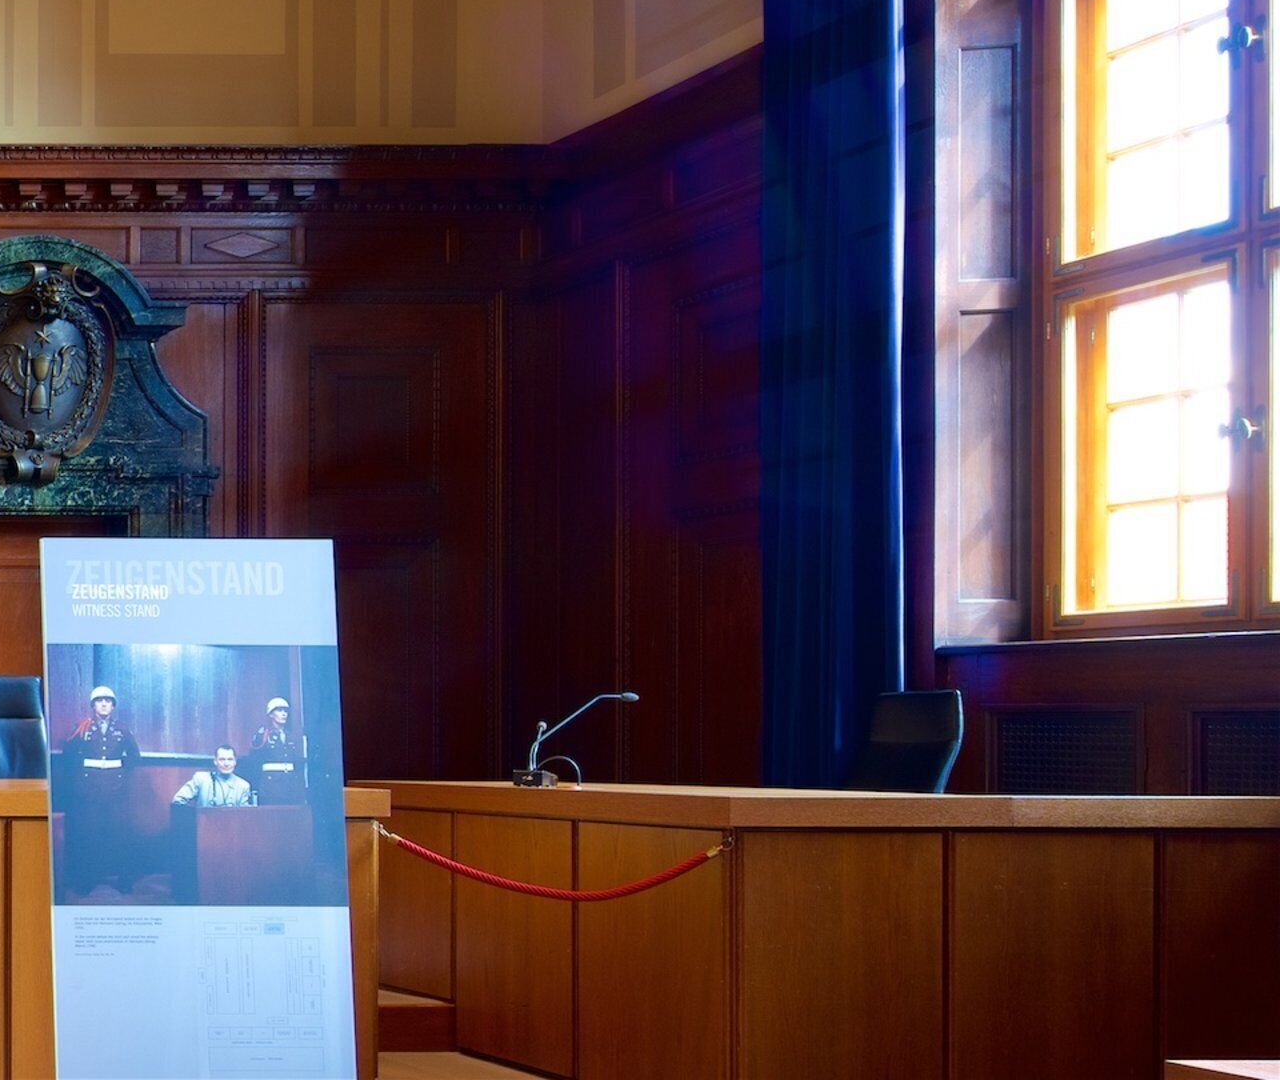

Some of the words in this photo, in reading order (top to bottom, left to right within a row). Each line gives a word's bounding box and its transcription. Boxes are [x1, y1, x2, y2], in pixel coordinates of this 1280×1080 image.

[64, 560, 285, 596] ZEUGENSTAND
[71, 584, 169, 600] ZEUGENSTAND
[71, 603, 121, 618] WITNESS
[124, 604, 160, 618] STAND
